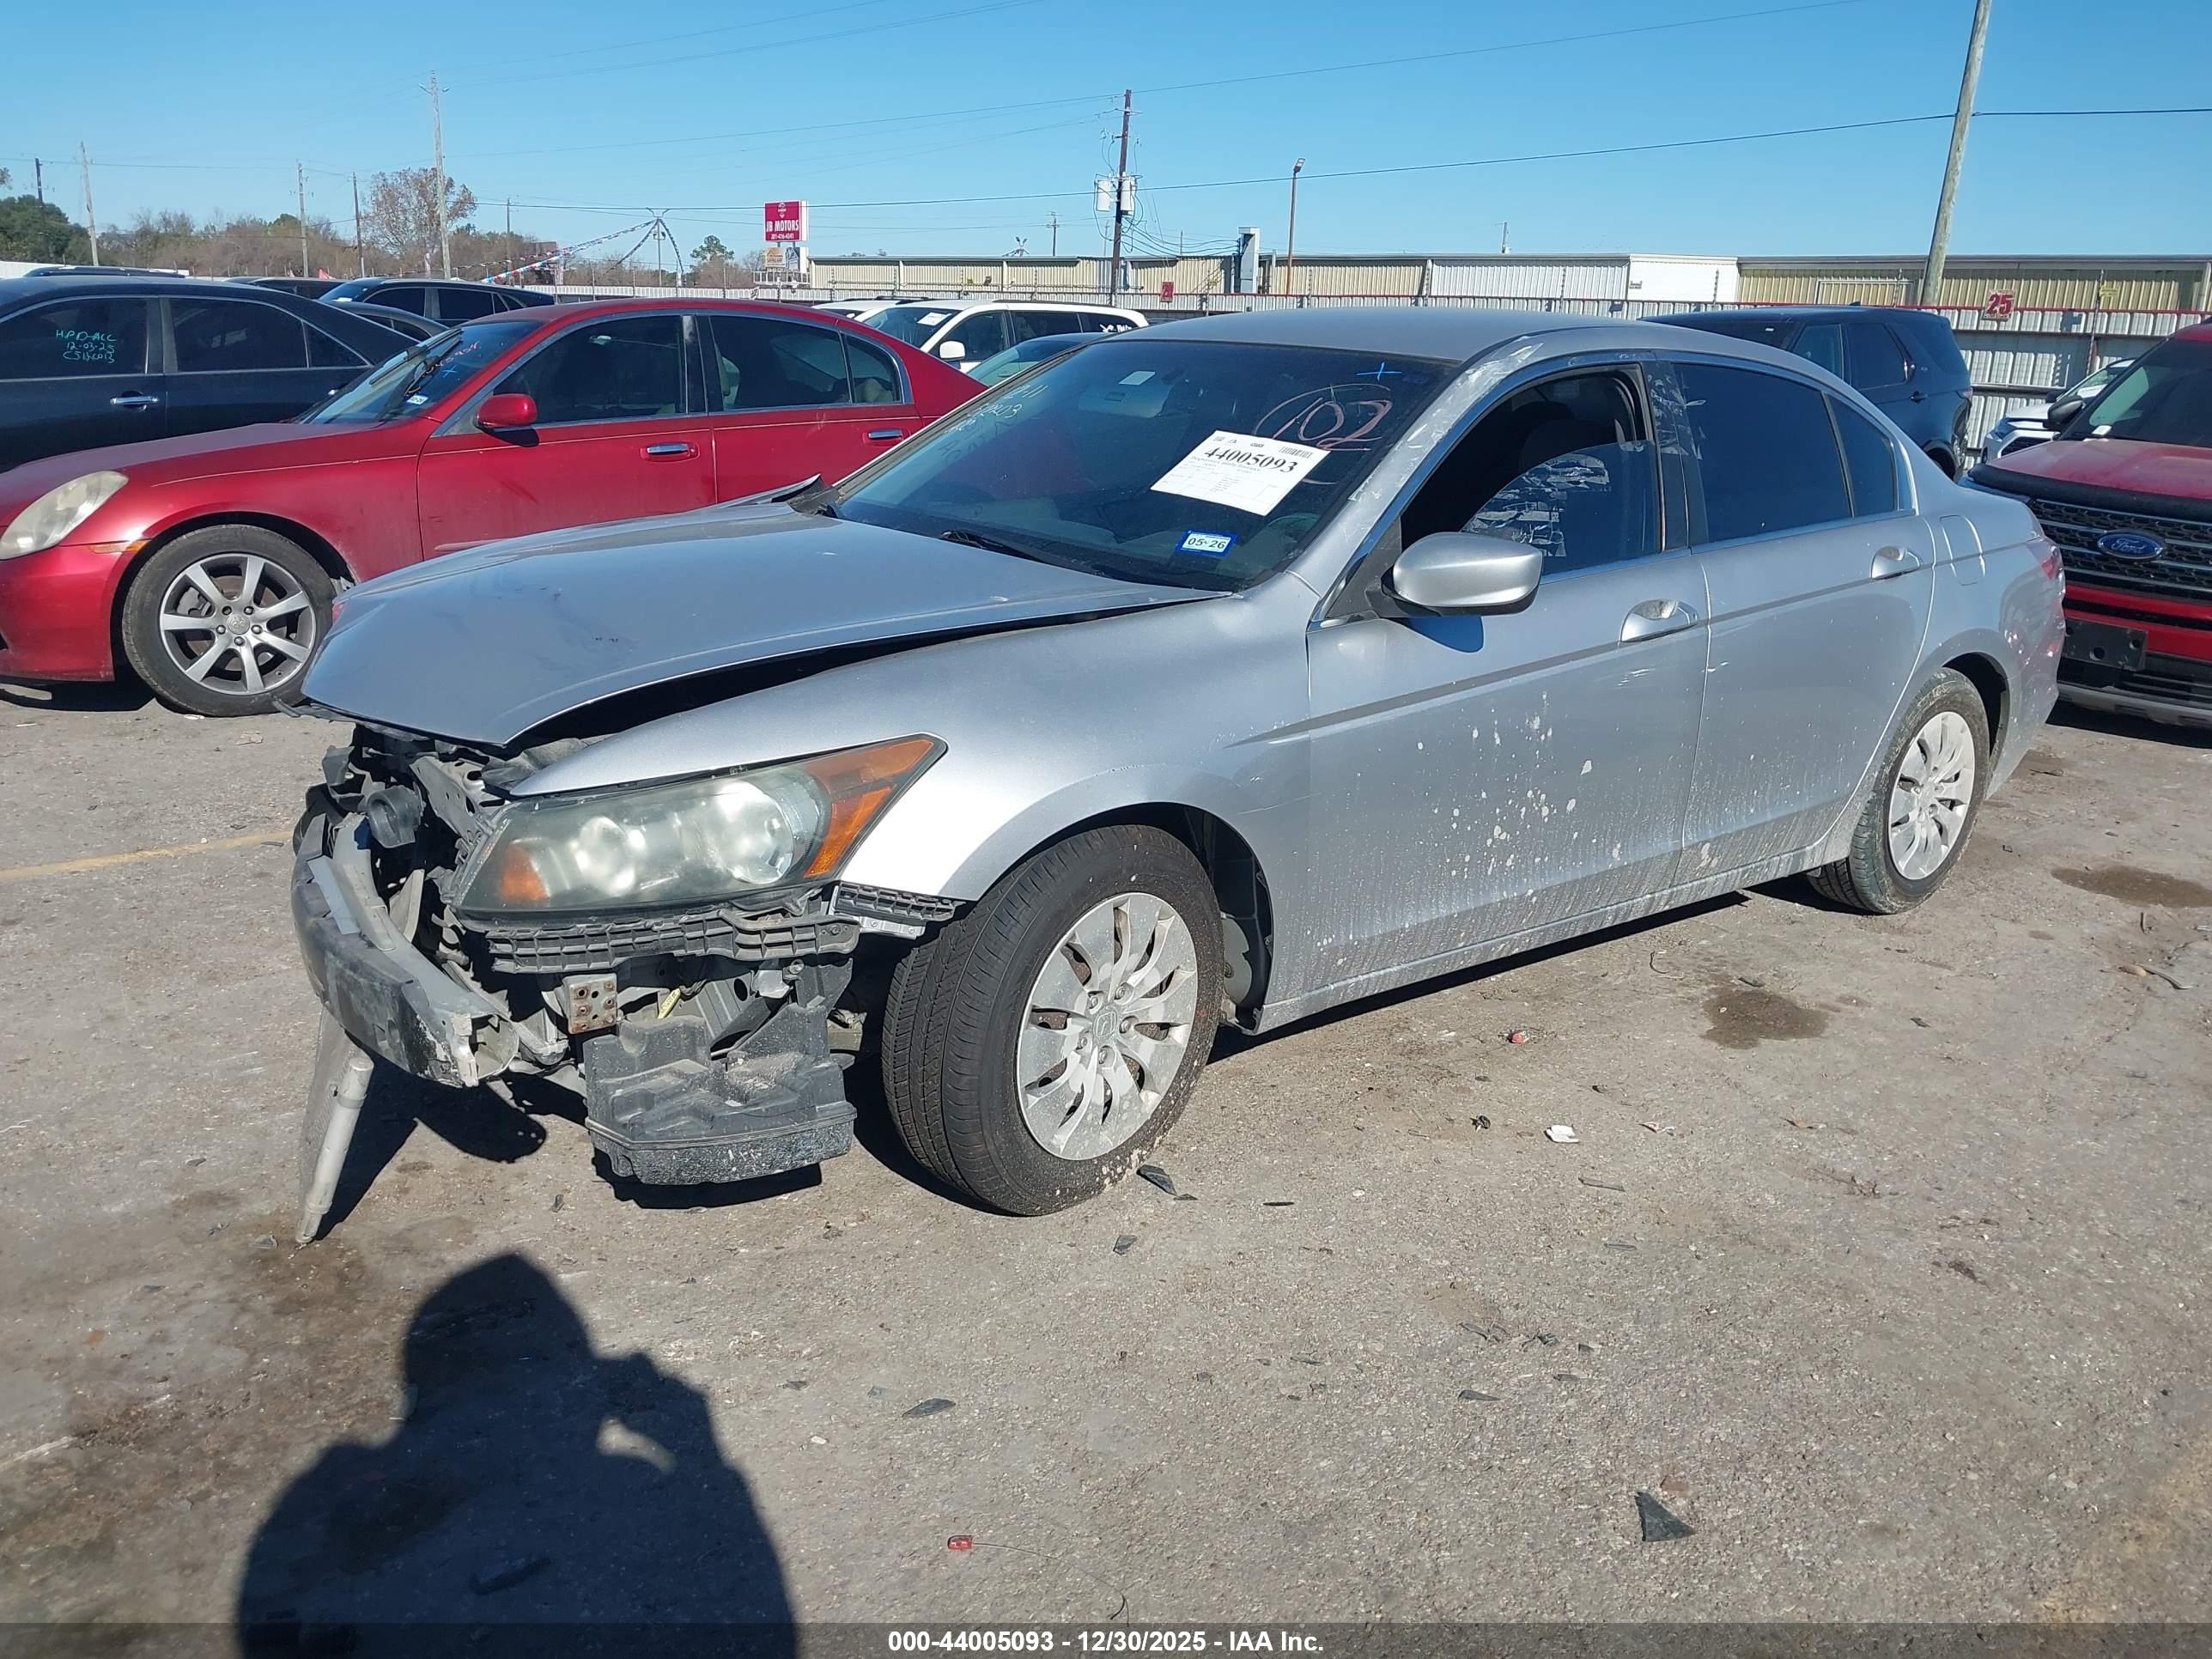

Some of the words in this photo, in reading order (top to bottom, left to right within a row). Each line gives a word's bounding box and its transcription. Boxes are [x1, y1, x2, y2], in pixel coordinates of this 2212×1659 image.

[766, 221, 774, 233] JB
[775, 220, 799, 232] MOTORS
[1986, 294, 2014, 315] 25
[1204, 447, 1298, 473] 44005093
[1188, 538, 1206, 546] 05
[1208, 540, 1227, 550] 26
[2111, 538, 2148, 554] Ford
